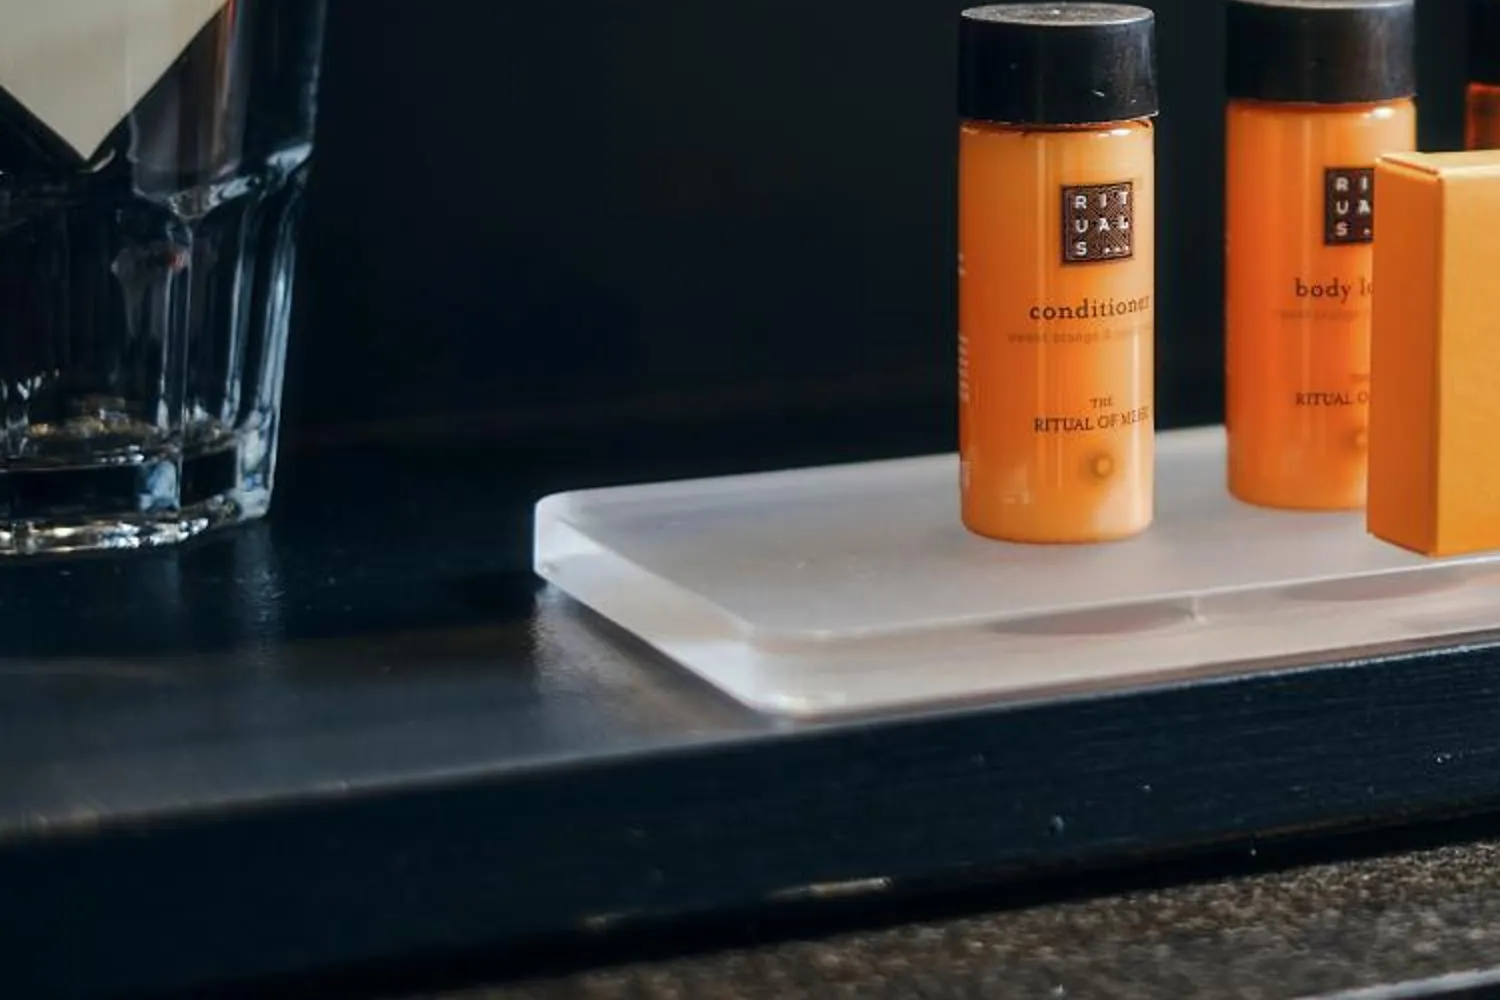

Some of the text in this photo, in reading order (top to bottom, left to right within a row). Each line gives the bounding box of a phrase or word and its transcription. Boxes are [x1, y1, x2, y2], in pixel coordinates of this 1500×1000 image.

[1295, 277, 1351, 304] body
[1295, 392, 1353, 406] RITUAL
[1033, 416, 1095, 434] RITUAL
[1097, 411, 1120, 429] OF
